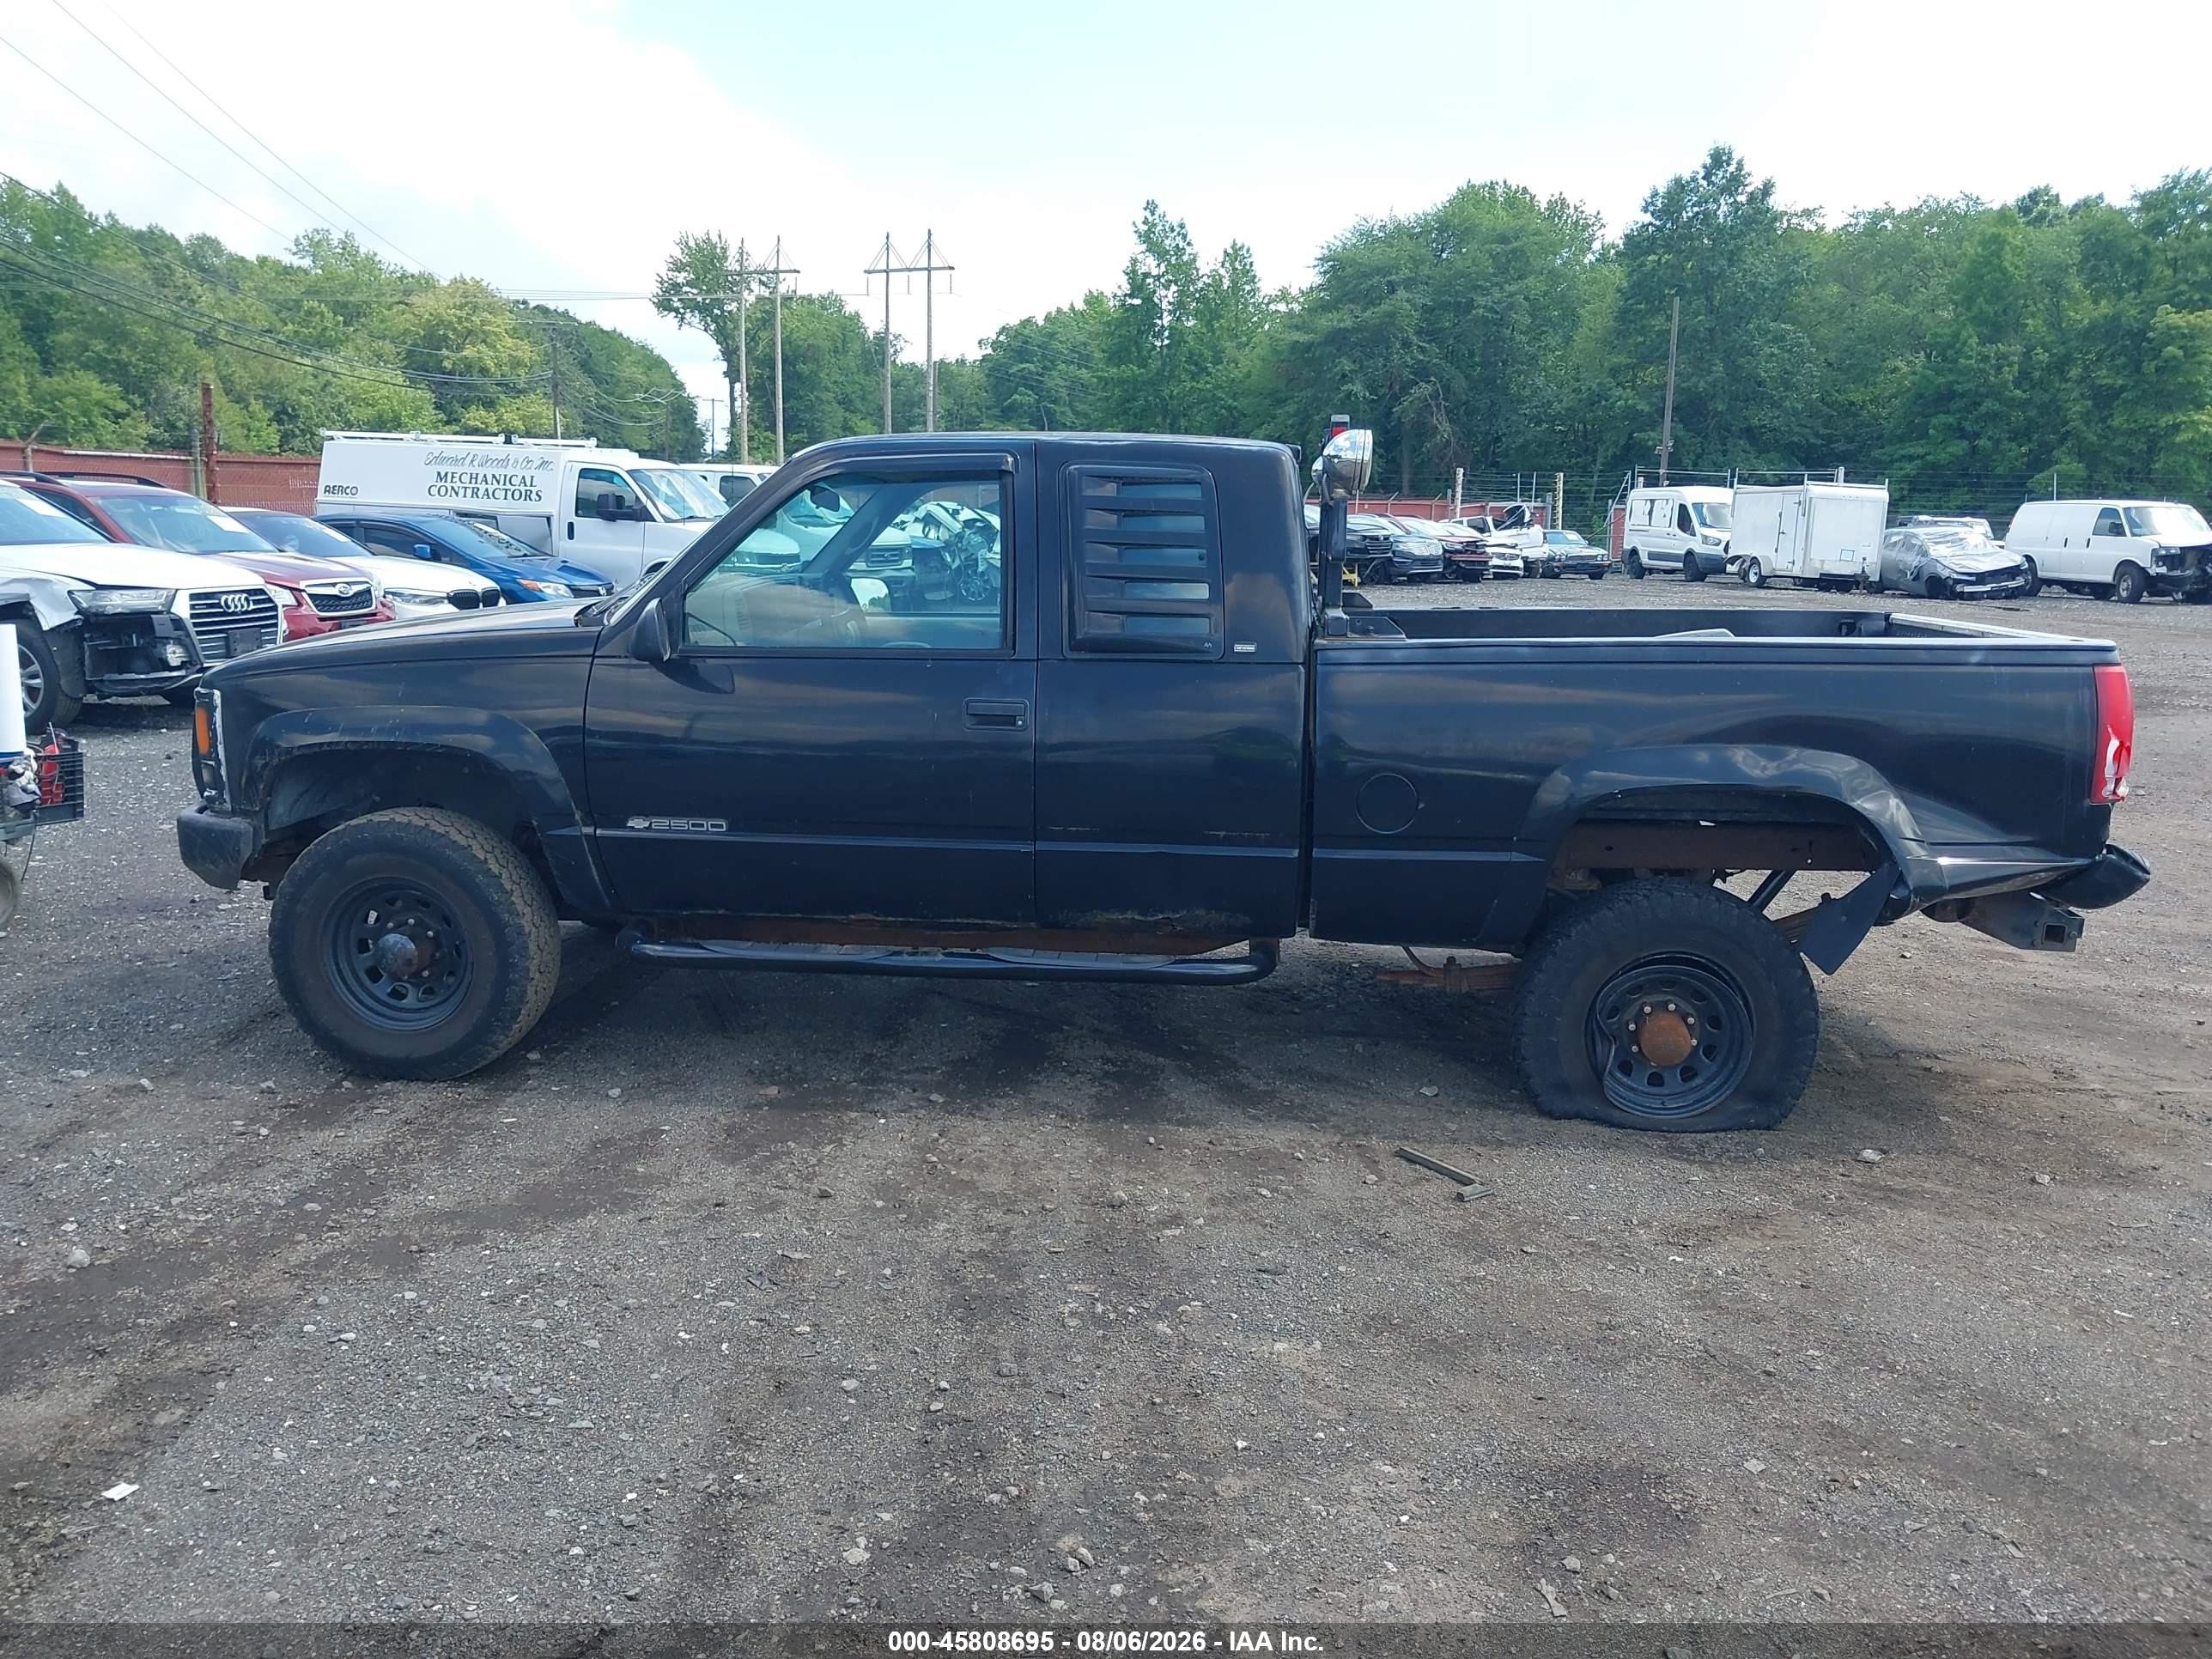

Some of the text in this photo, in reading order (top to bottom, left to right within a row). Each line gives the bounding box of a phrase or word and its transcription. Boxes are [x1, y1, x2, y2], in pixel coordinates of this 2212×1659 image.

[424, 451, 471, 467] Edward
[478, 453, 510, 469] Woods
[435, 471, 537, 487] MECHANICAL
[324, 484, 359, 495] AERCO
[428, 484, 543, 501] CONTRACTORS
[651, 819, 726, 832] 2500
